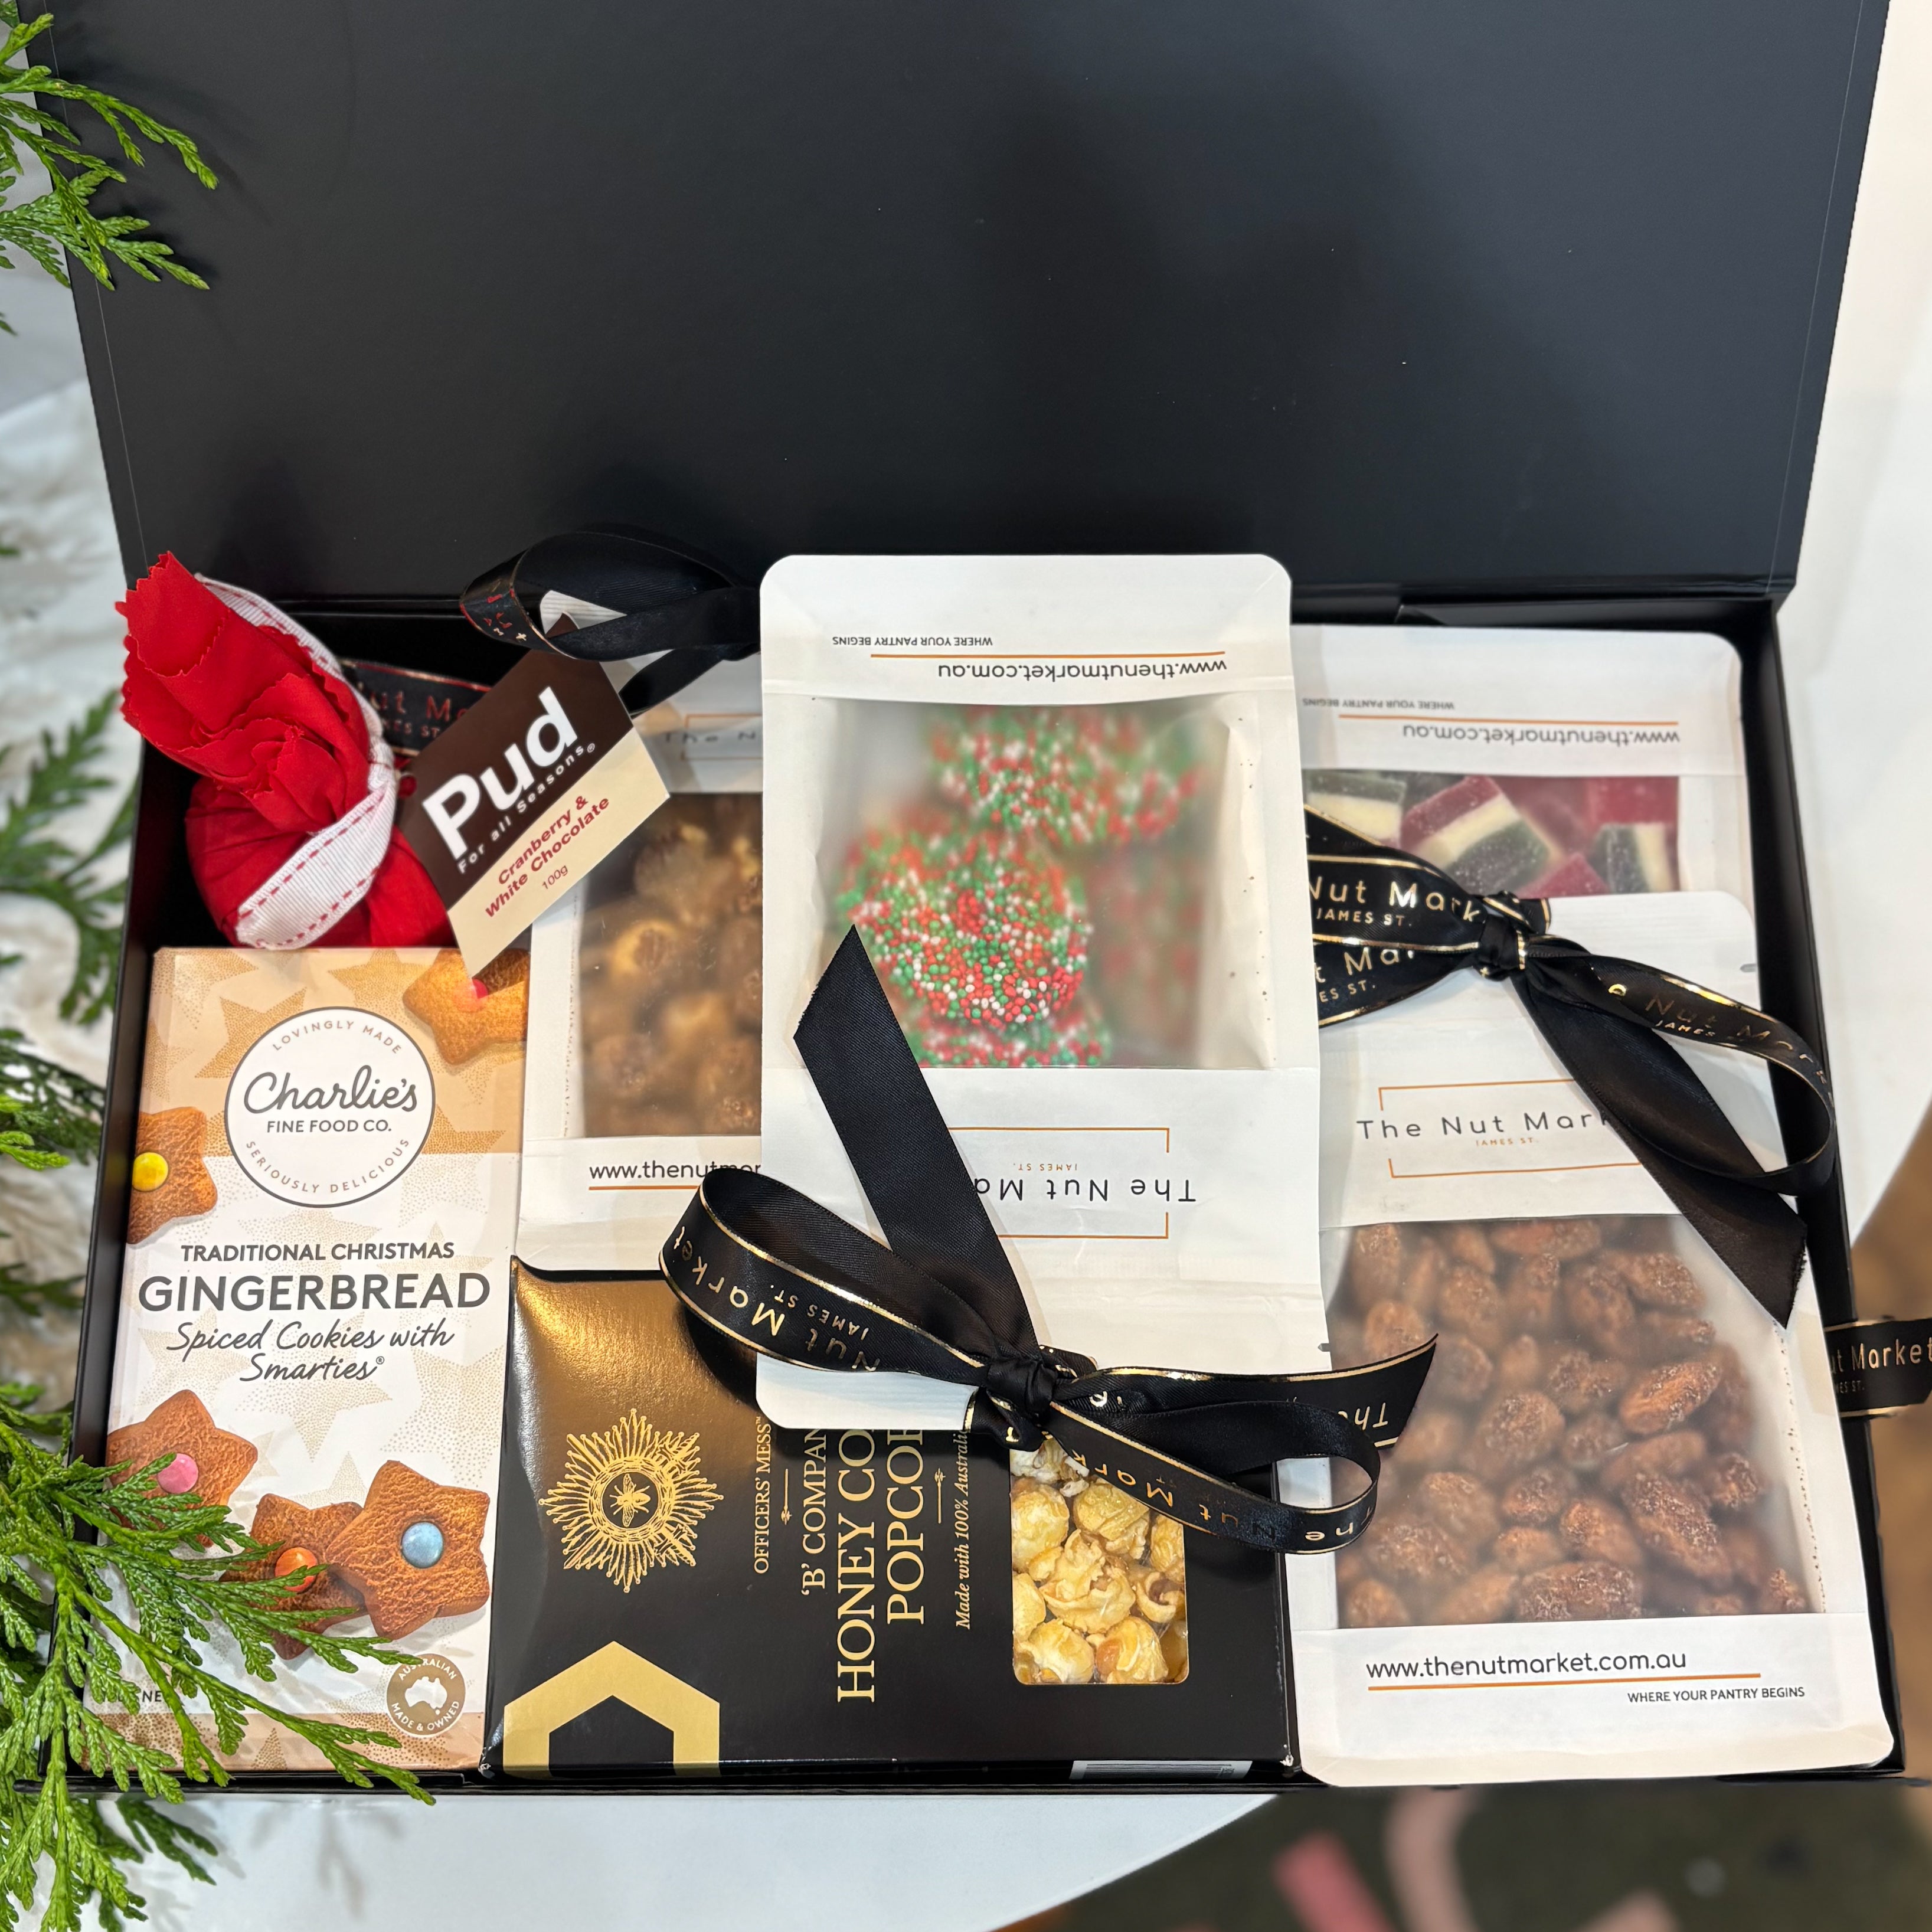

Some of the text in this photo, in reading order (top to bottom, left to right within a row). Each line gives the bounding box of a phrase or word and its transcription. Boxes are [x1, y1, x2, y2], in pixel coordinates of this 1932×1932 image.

[832, 636, 993, 646] WHERE YOUR PANTRY BEGINS
[938, 660, 1227, 682] www.thenutmarket.com.au
[1302, 698, 1455, 710] WHERE YOUR PANTRY BEGINS
[1403, 724, 1681, 747] www.thenutmarket.com.au
[421, 685, 578, 860] Pud
[457, 843, 486, 874] For
[491, 815, 512, 842] all
[498, 795, 589, 885] Cranberry &
[485, 797, 610, 918] White Chocolate
[541, 865, 568, 890] 100g
[1316, 907, 1413, 927] JAMES ST.
[1348, 979, 1376, 995] ST.
[272, 1019, 402, 1055] LOVINGLY MADE
[243, 1064, 417, 1114] Charlie's
[266, 1119, 393, 1133] FINE FOOD CO.
[1356, 1120, 1422, 1140] The
[1441, 1115, 1505, 1136] Nut
[246, 1138, 410, 1194] SERIOUSLY DELICIOUS
[1013, 1163, 1032, 1171] ST.
[1047, 1179, 1109, 1202] Nut
[1130, 1179, 1197, 1202] The
[181, 1241, 455, 1262] TRADITIONAL CHRISTMAS
[138, 1271, 491, 1312] GINGERBREAD
[674, 1225, 881, 1372] Nut Market
[770, 1284, 799, 1308] ST.
[166, 1317, 455, 1362] Spiced Cookies with
[754, 1477, 771, 1574] OFFICERS'
[954, 1498, 970, 1540] 100%
[954, 1539, 970, 1579] with
[836, 1512, 876, 1704] HONEY
[955, 1583, 971, 1630] Made
[1365, 1650, 1687, 1679] www.thenutmarket.com.au
[1626, 1686, 1806, 1704] WHERE YOUR PANTRY BEGINS
[391, 1700, 460, 1732] MADE & OWNED
